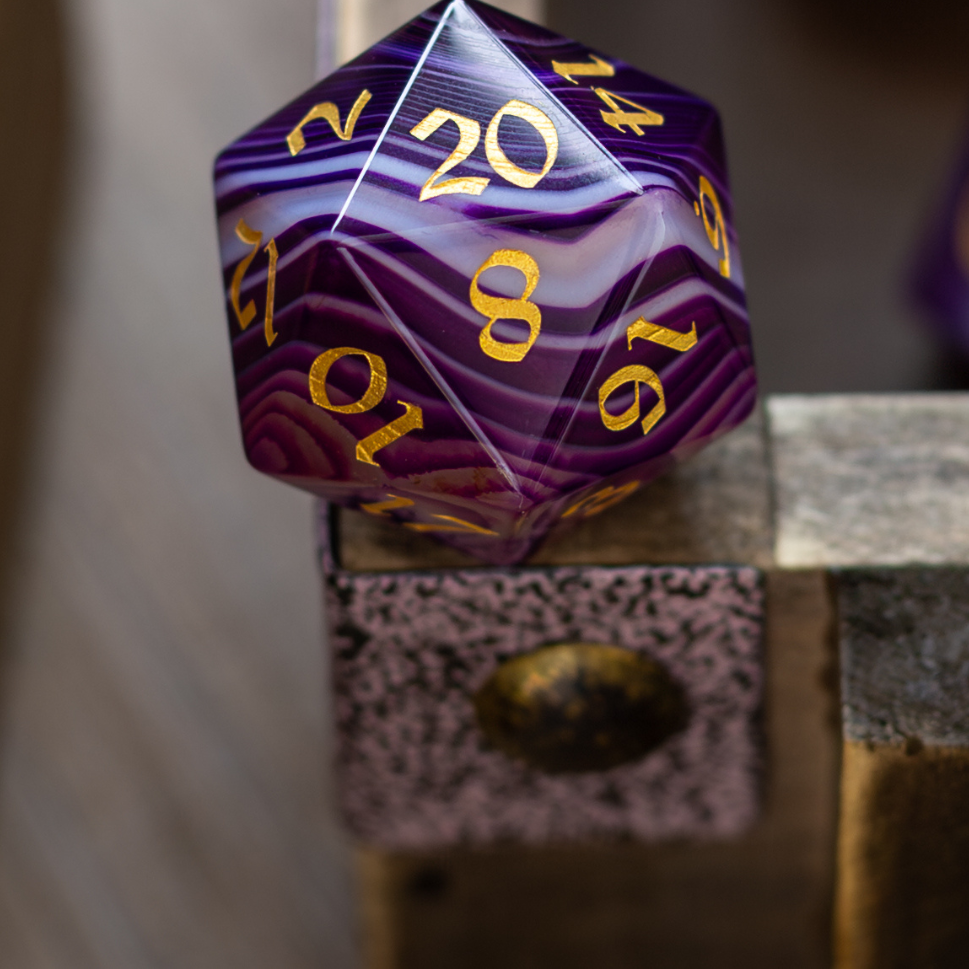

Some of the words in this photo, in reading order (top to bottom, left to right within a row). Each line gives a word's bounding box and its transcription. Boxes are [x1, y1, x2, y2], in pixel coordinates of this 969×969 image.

[286, 89, 372, 157] 2
[552, 54, 664, 136] 14
[410, 99, 559, 202] 20
[469, 248, 542, 362] 8
[308, 346, 424, 467] 10
[599, 316, 698, 435] 16
